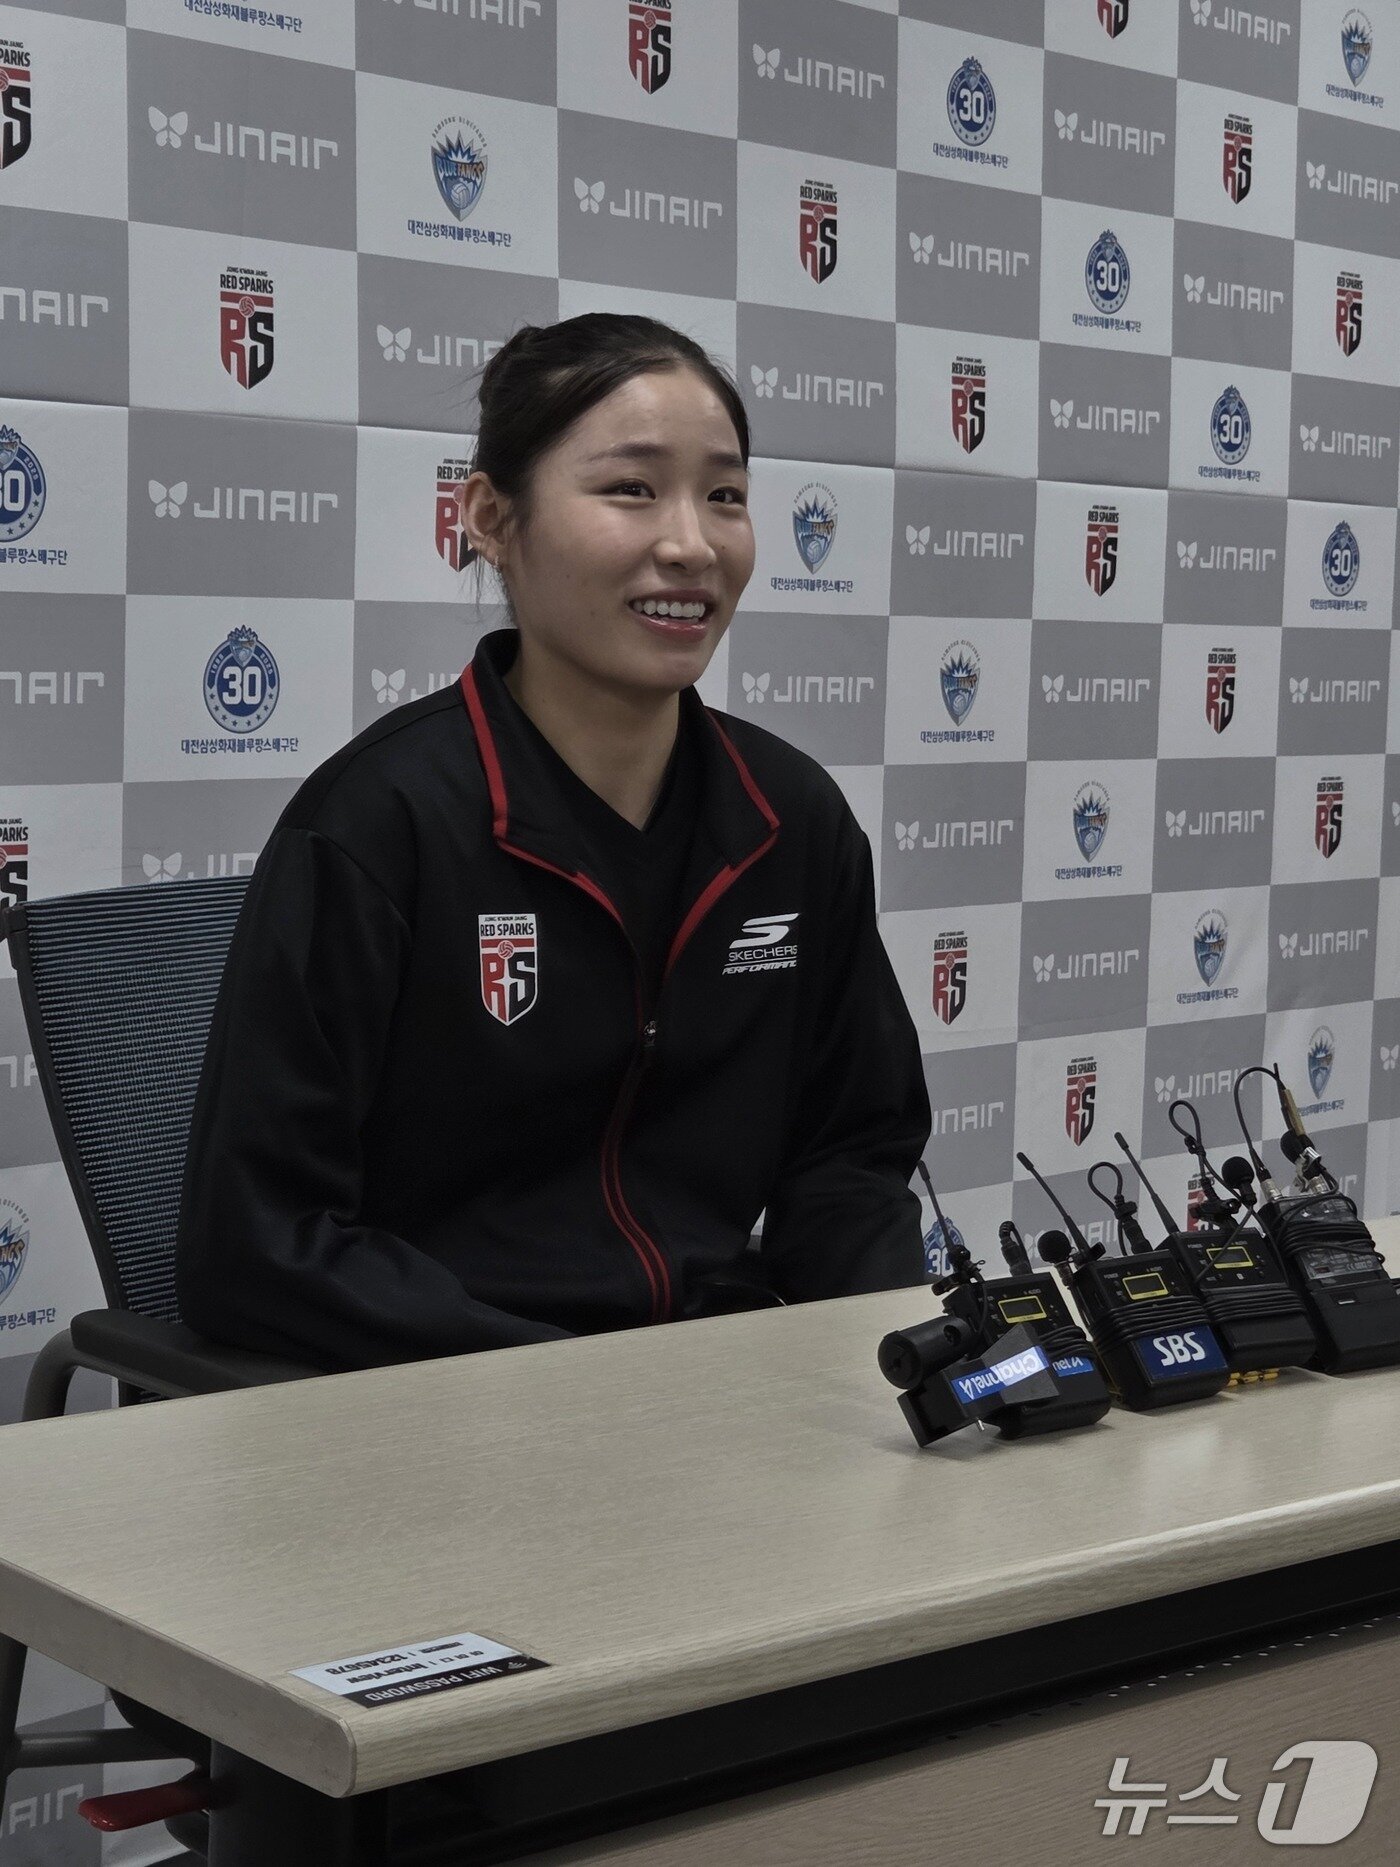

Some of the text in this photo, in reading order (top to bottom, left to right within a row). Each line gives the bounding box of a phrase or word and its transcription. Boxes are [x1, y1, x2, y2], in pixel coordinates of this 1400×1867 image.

[959, 88, 985, 124] 30
[220, 274, 273, 294] RED SPARKS
[1095, 260, 1120, 293] 30
[1219, 414, 1242, 444] 30
[437, 466, 453, 480] RED
[0, 470, 26, 511] 0
[1330, 548, 1351, 577] 30
[222, 665, 262, 705] 30
[0, 826, 28, 842] ARKS
[480, 922, 534, 937] RED SPARKS
[729, 945, 798, 962] SKECHERS
[1153, 1331, 1206, 1367] SBS
[365, 1666, 503, 1701] WIFI PASSWORD
